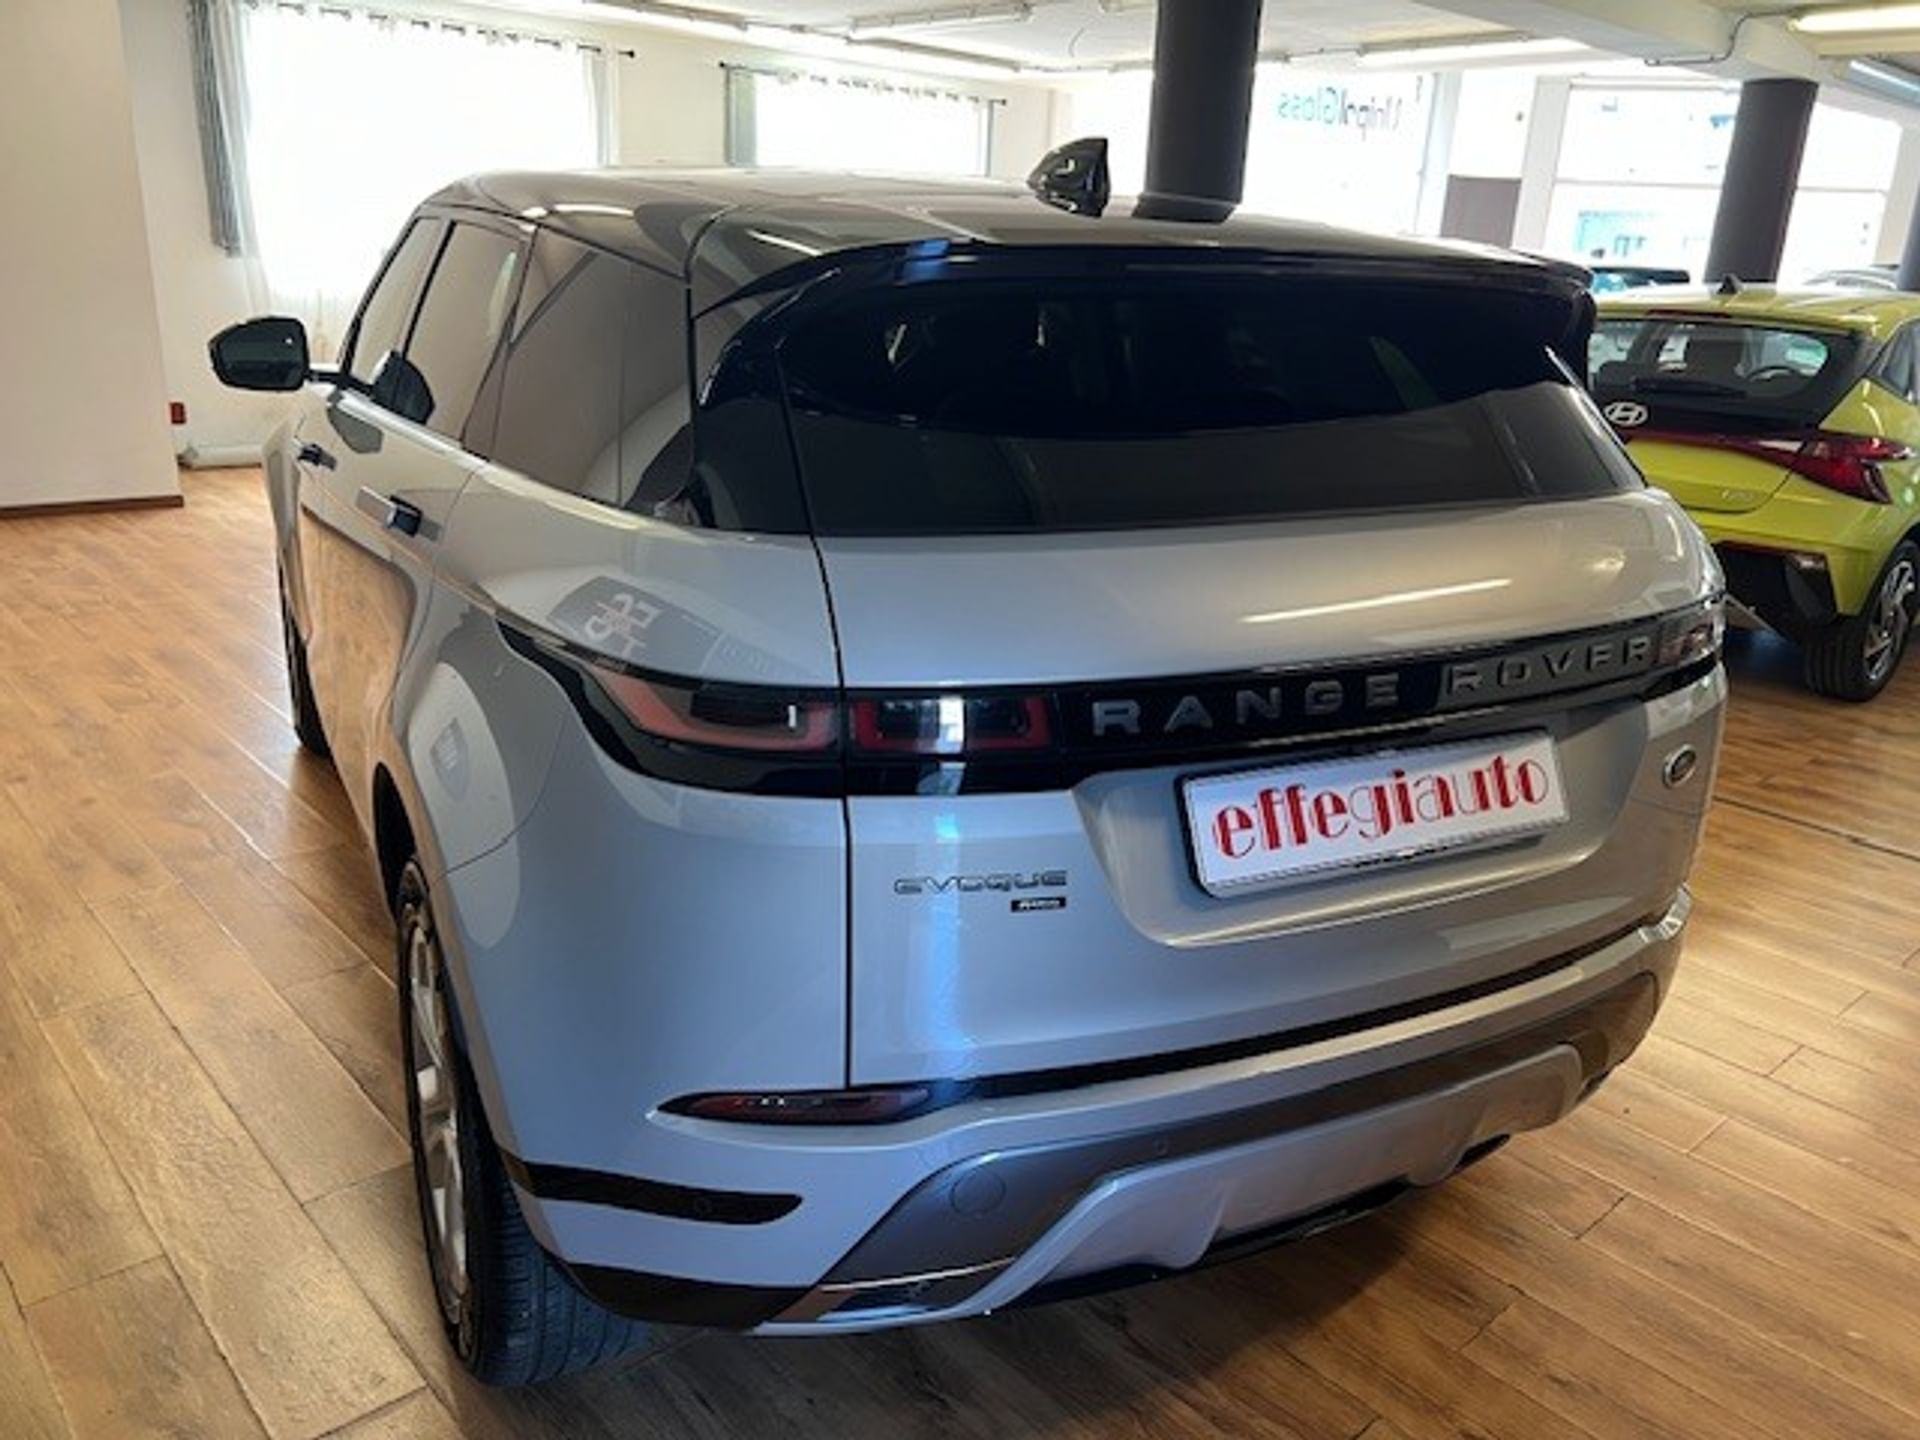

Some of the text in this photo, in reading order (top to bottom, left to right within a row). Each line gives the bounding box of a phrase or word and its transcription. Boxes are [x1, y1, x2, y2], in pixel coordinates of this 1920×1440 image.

[1092, 635, 1651, 736] RANGE ROVER
[1212, 755, 1548, 859] effegiauto
[894, 870, 1067, 894] EVOQUE
